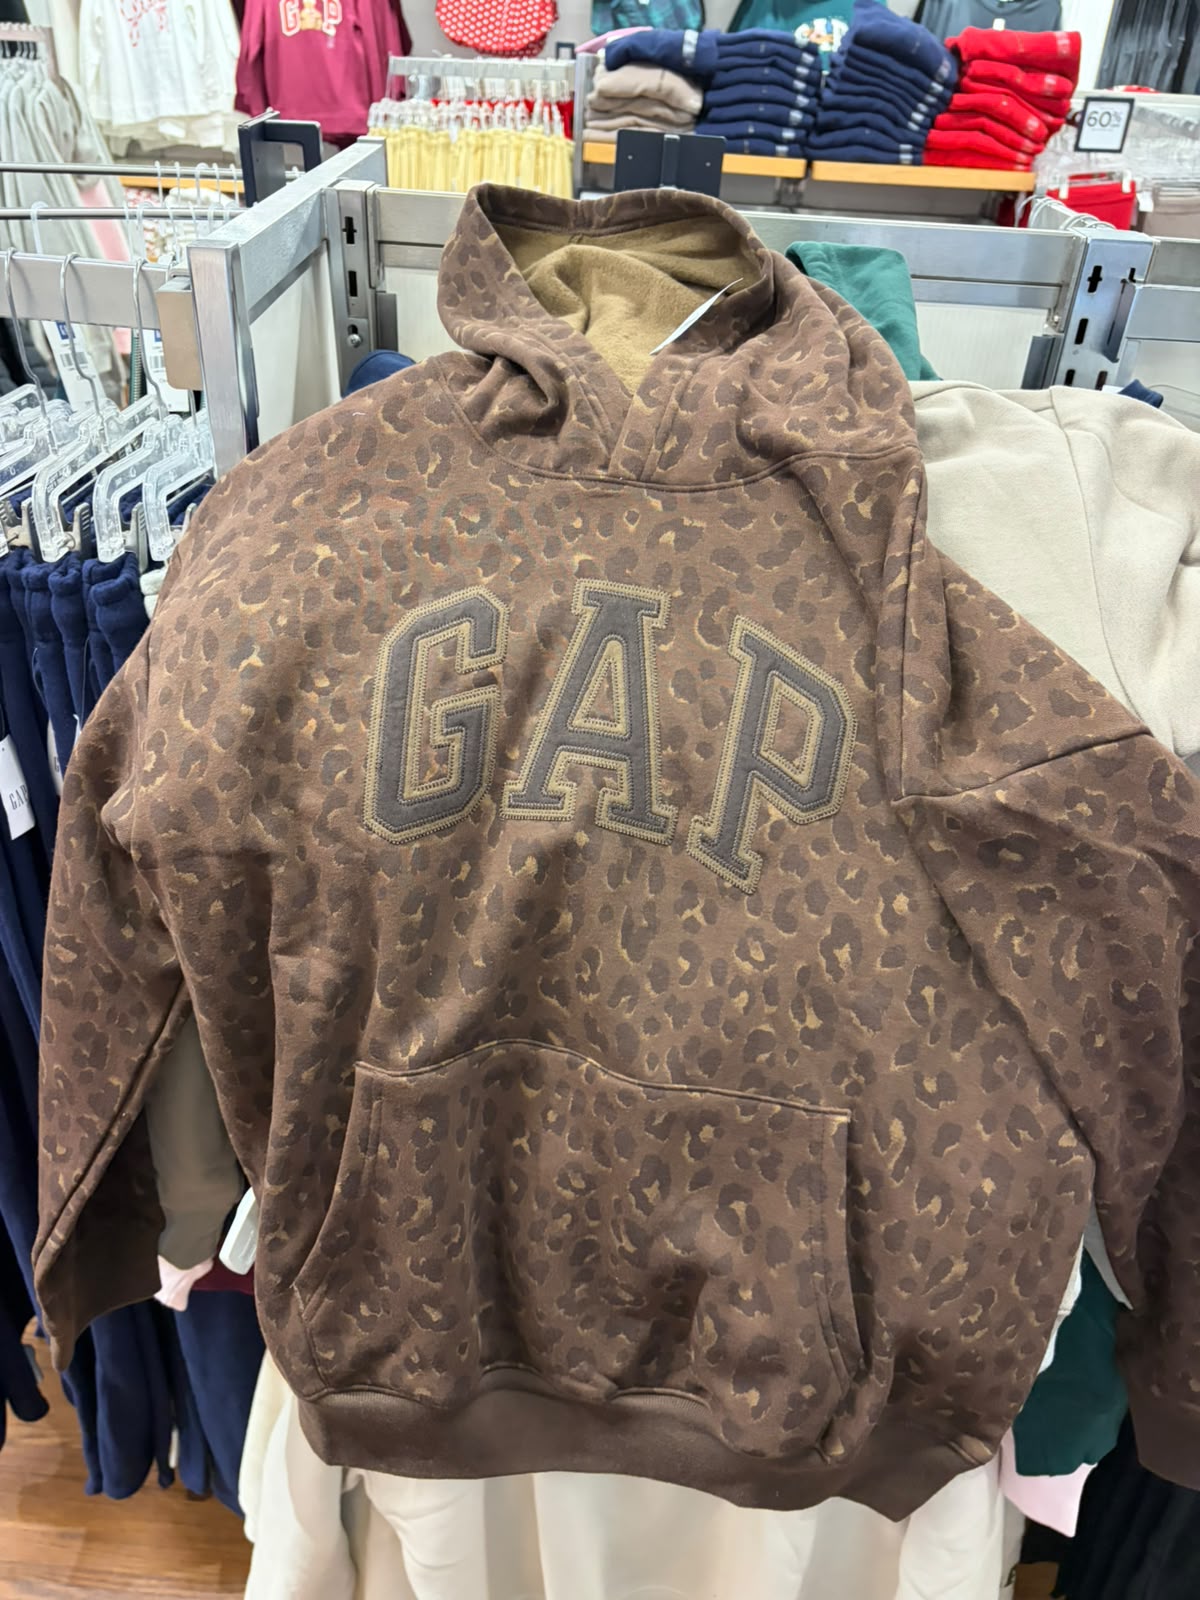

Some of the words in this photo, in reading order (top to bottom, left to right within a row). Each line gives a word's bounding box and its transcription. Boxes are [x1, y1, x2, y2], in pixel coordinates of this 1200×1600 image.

[279, 0, 343, 37] GP
[362, 577, 858, 896] GAP
[9, 784, 30, 810] GAP
